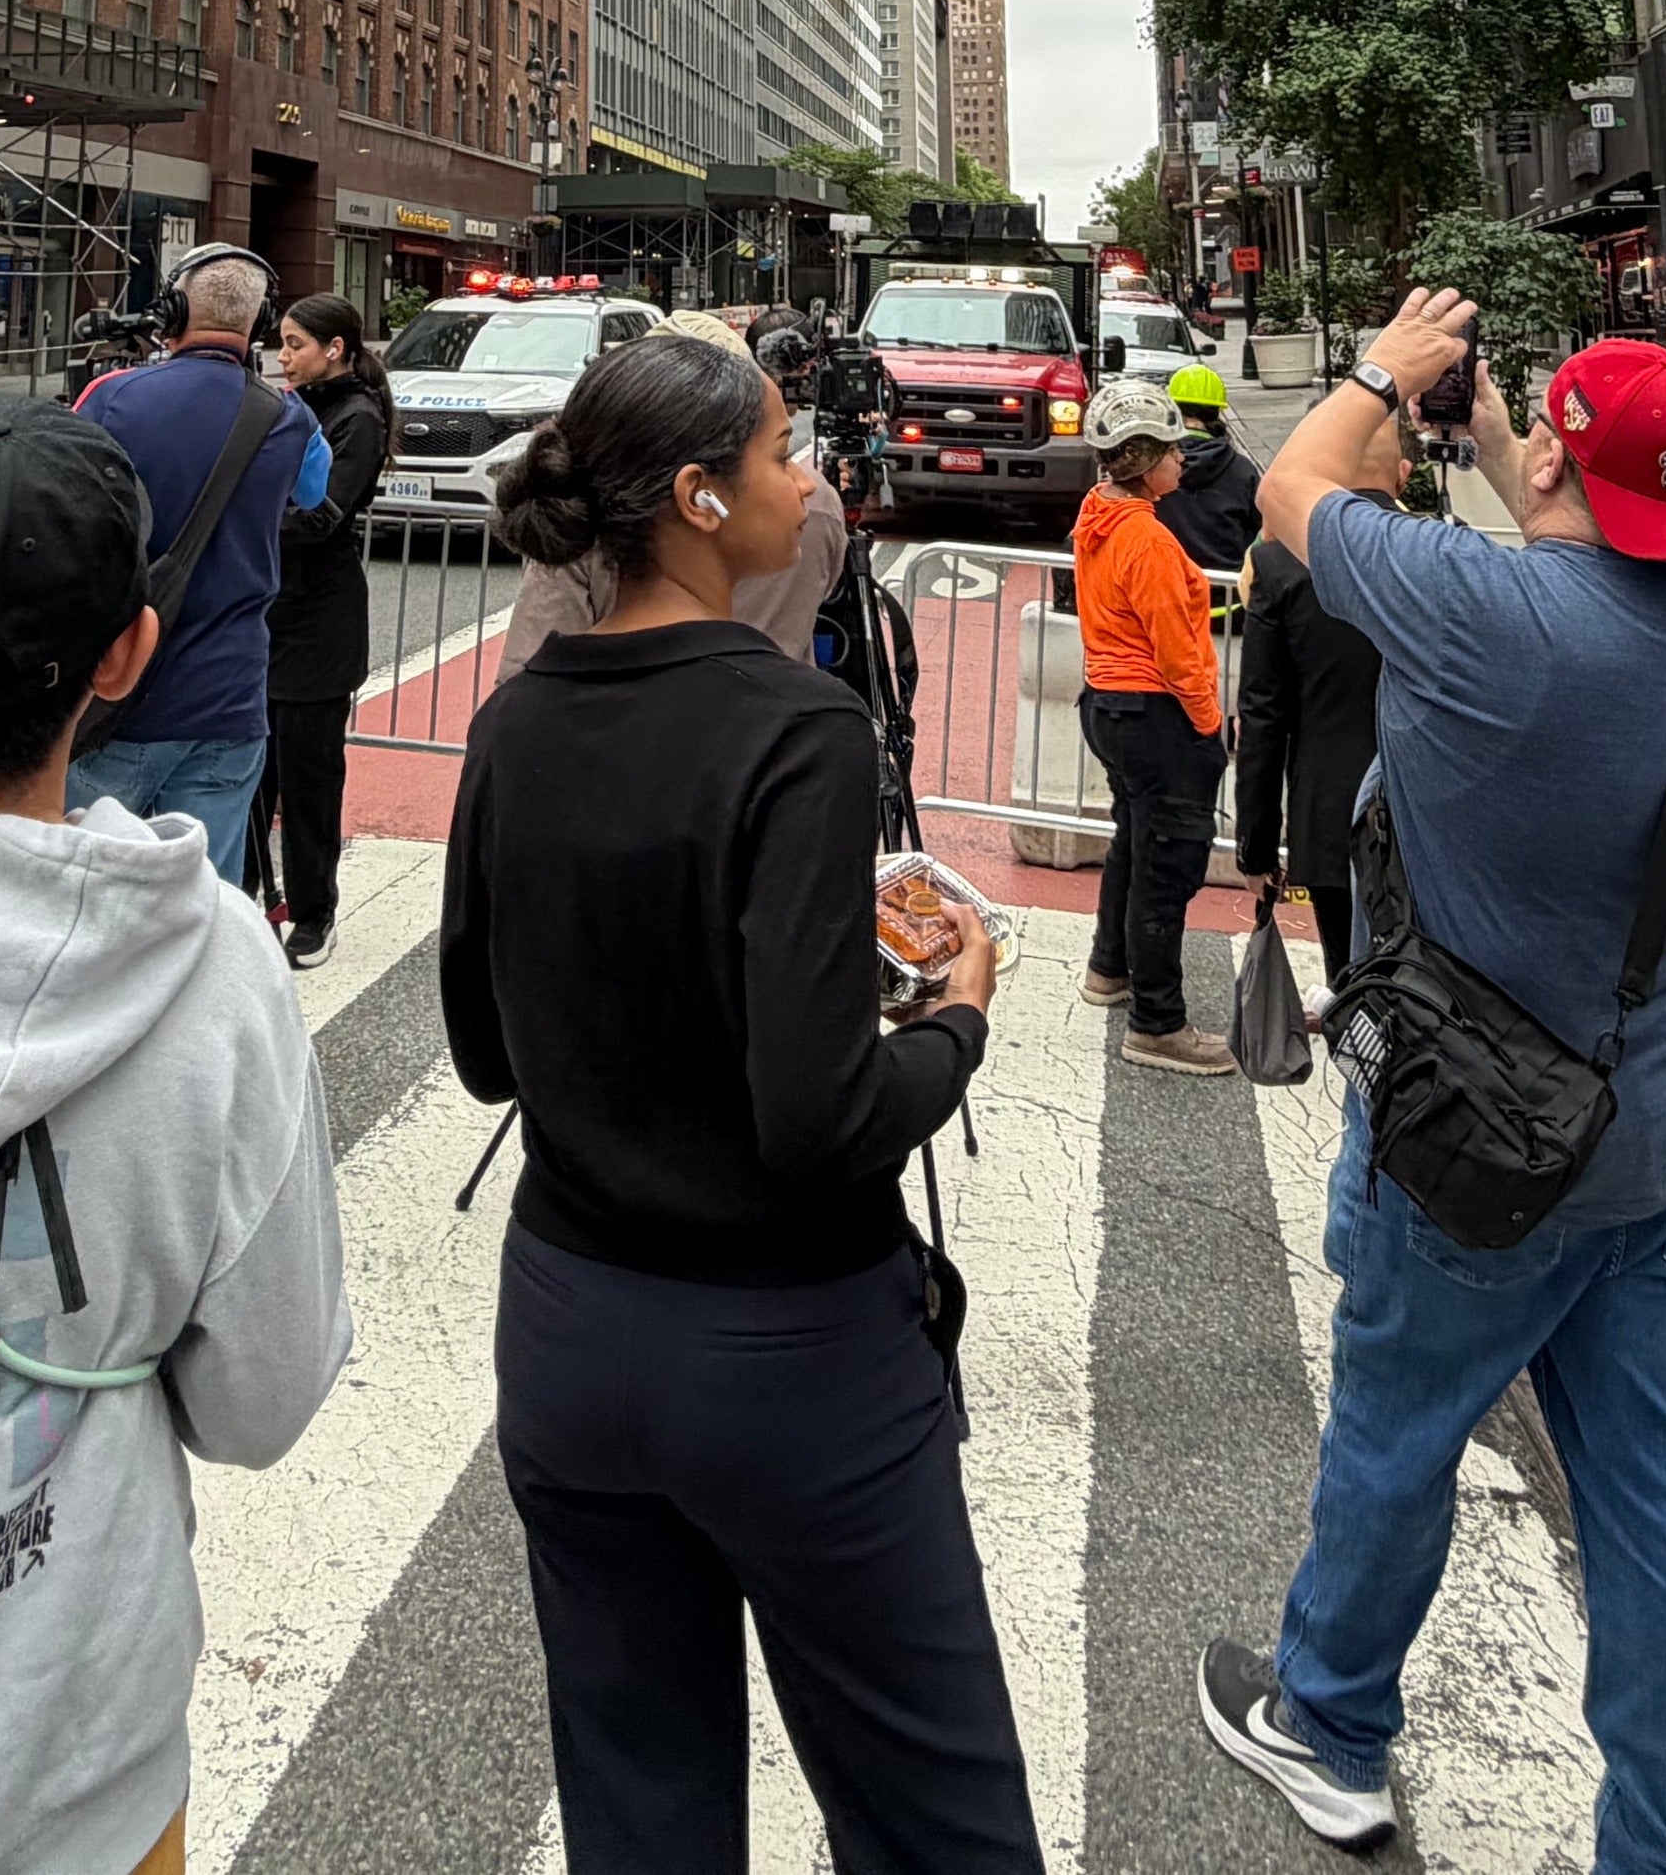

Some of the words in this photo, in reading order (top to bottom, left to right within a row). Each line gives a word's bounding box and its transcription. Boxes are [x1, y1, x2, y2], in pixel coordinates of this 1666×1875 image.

[1593, 106, 1610, 124] EAT
[419, 395, 487, 407] POLICE
[389, 482, 419, 496] 4360
